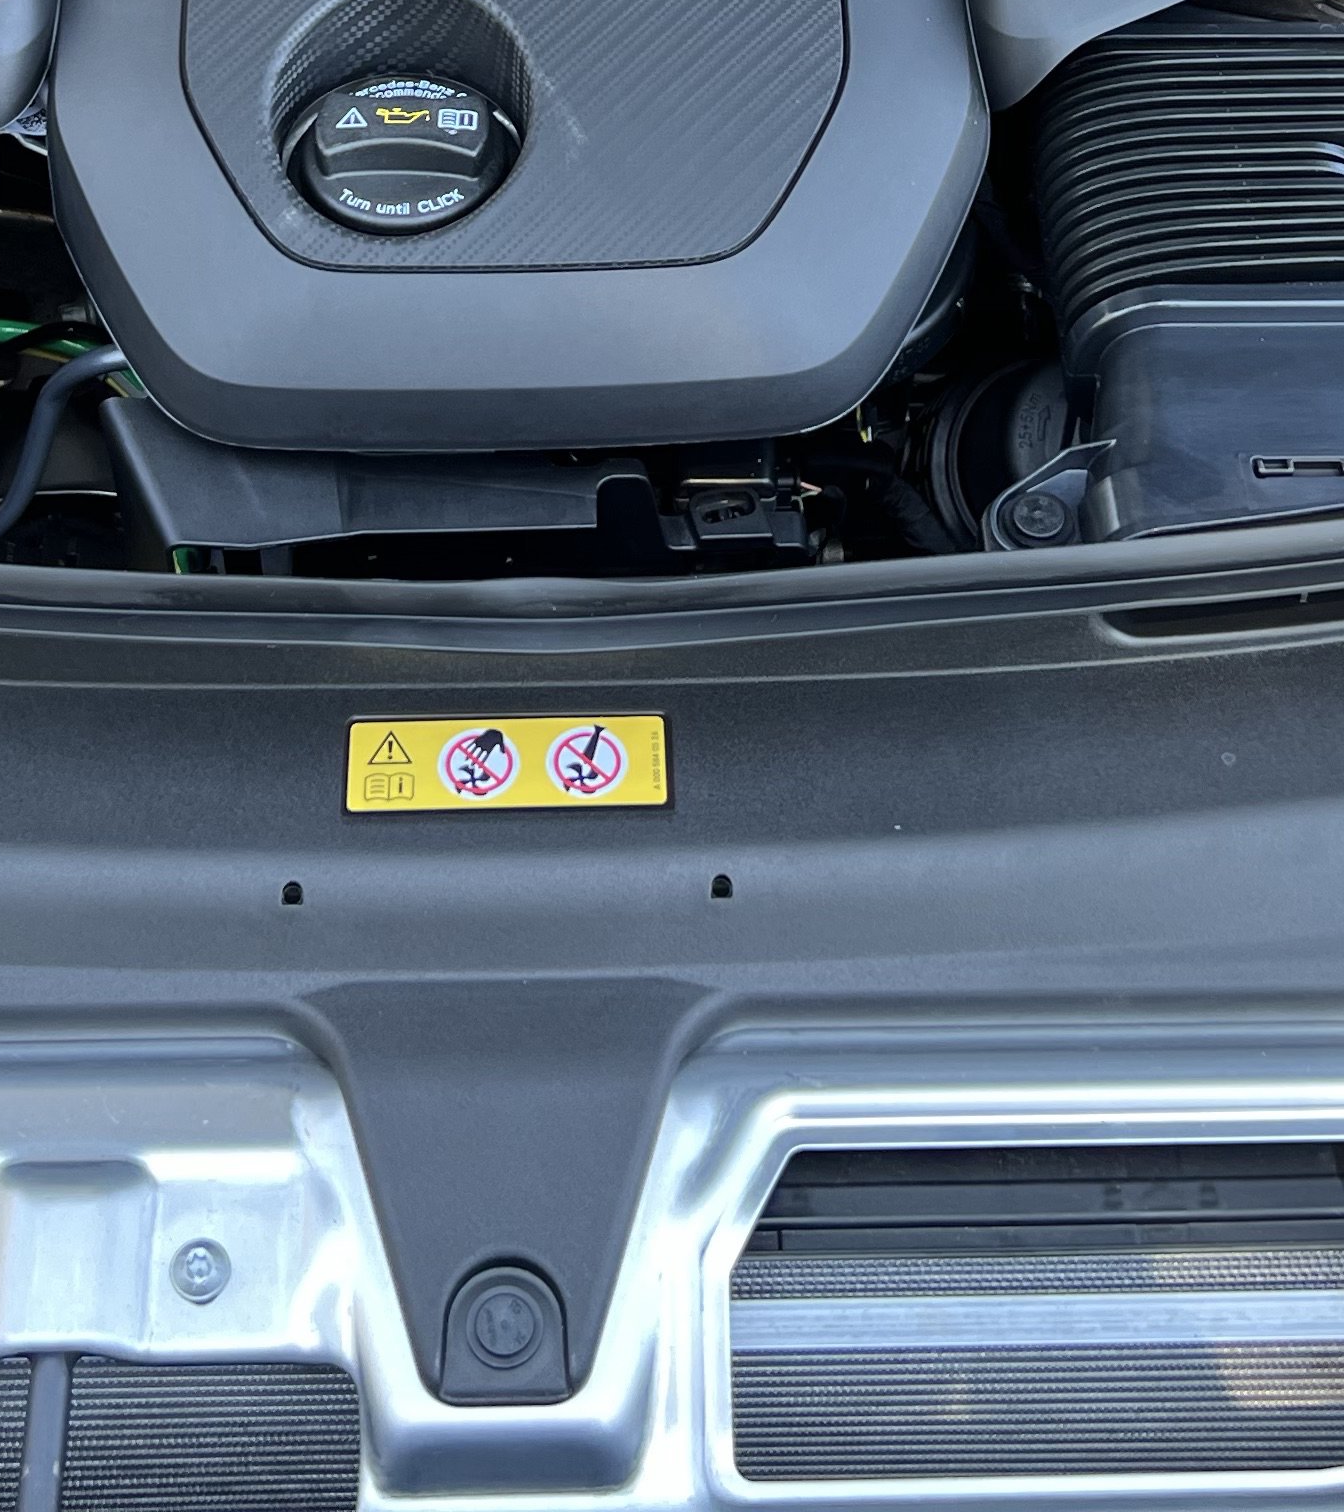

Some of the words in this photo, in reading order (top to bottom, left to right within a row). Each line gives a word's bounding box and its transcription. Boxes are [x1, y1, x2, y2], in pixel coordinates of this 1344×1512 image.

[349, 80, 455, 97] ercedes-Benz
[339, 188, 371, 210] Turn
[376, 202, 410, 215] until
[417, 188, 464, 213] CLICK
